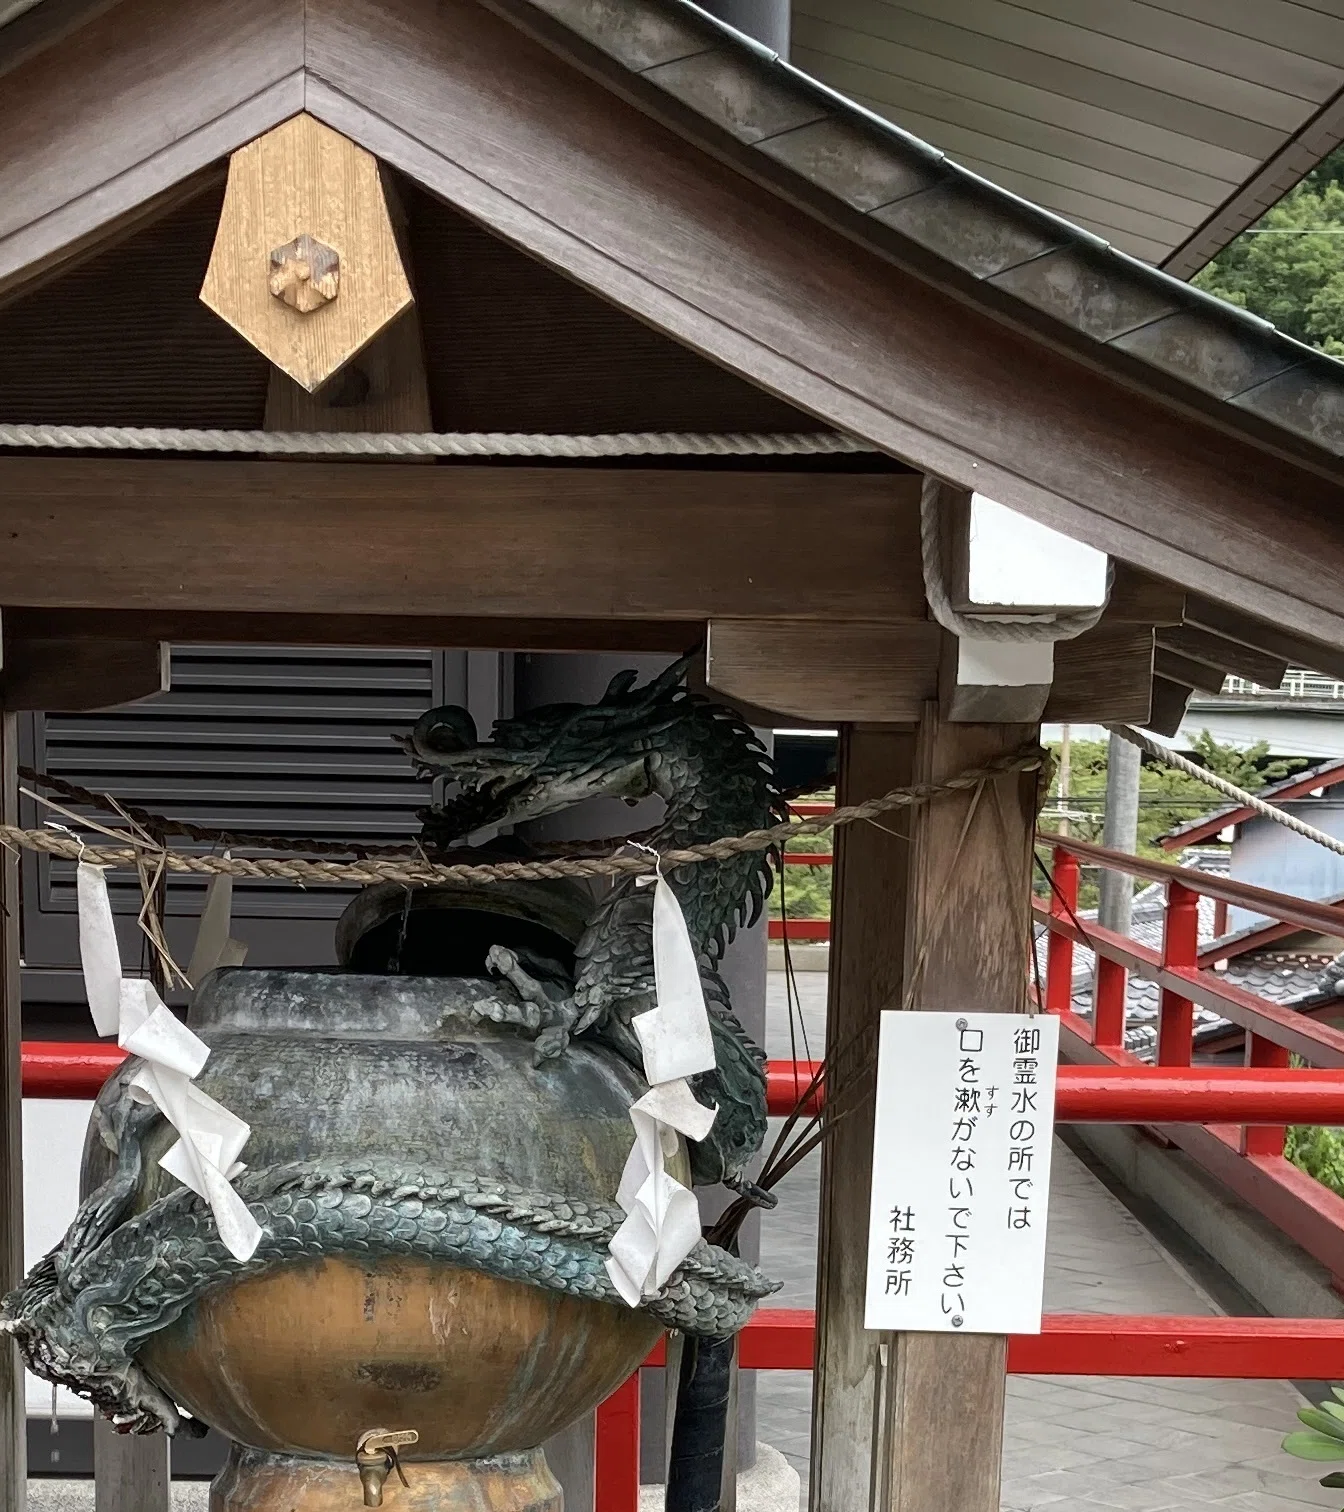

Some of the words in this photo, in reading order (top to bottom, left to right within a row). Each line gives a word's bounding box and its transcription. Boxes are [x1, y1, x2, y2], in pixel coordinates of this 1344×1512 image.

[941, 1028, 984, 1315] 口を漱がないで下さい
[1007, 1028, 1040, 1230] 御霊水の所では
[884, 1205, 917, 1297] 社務所
